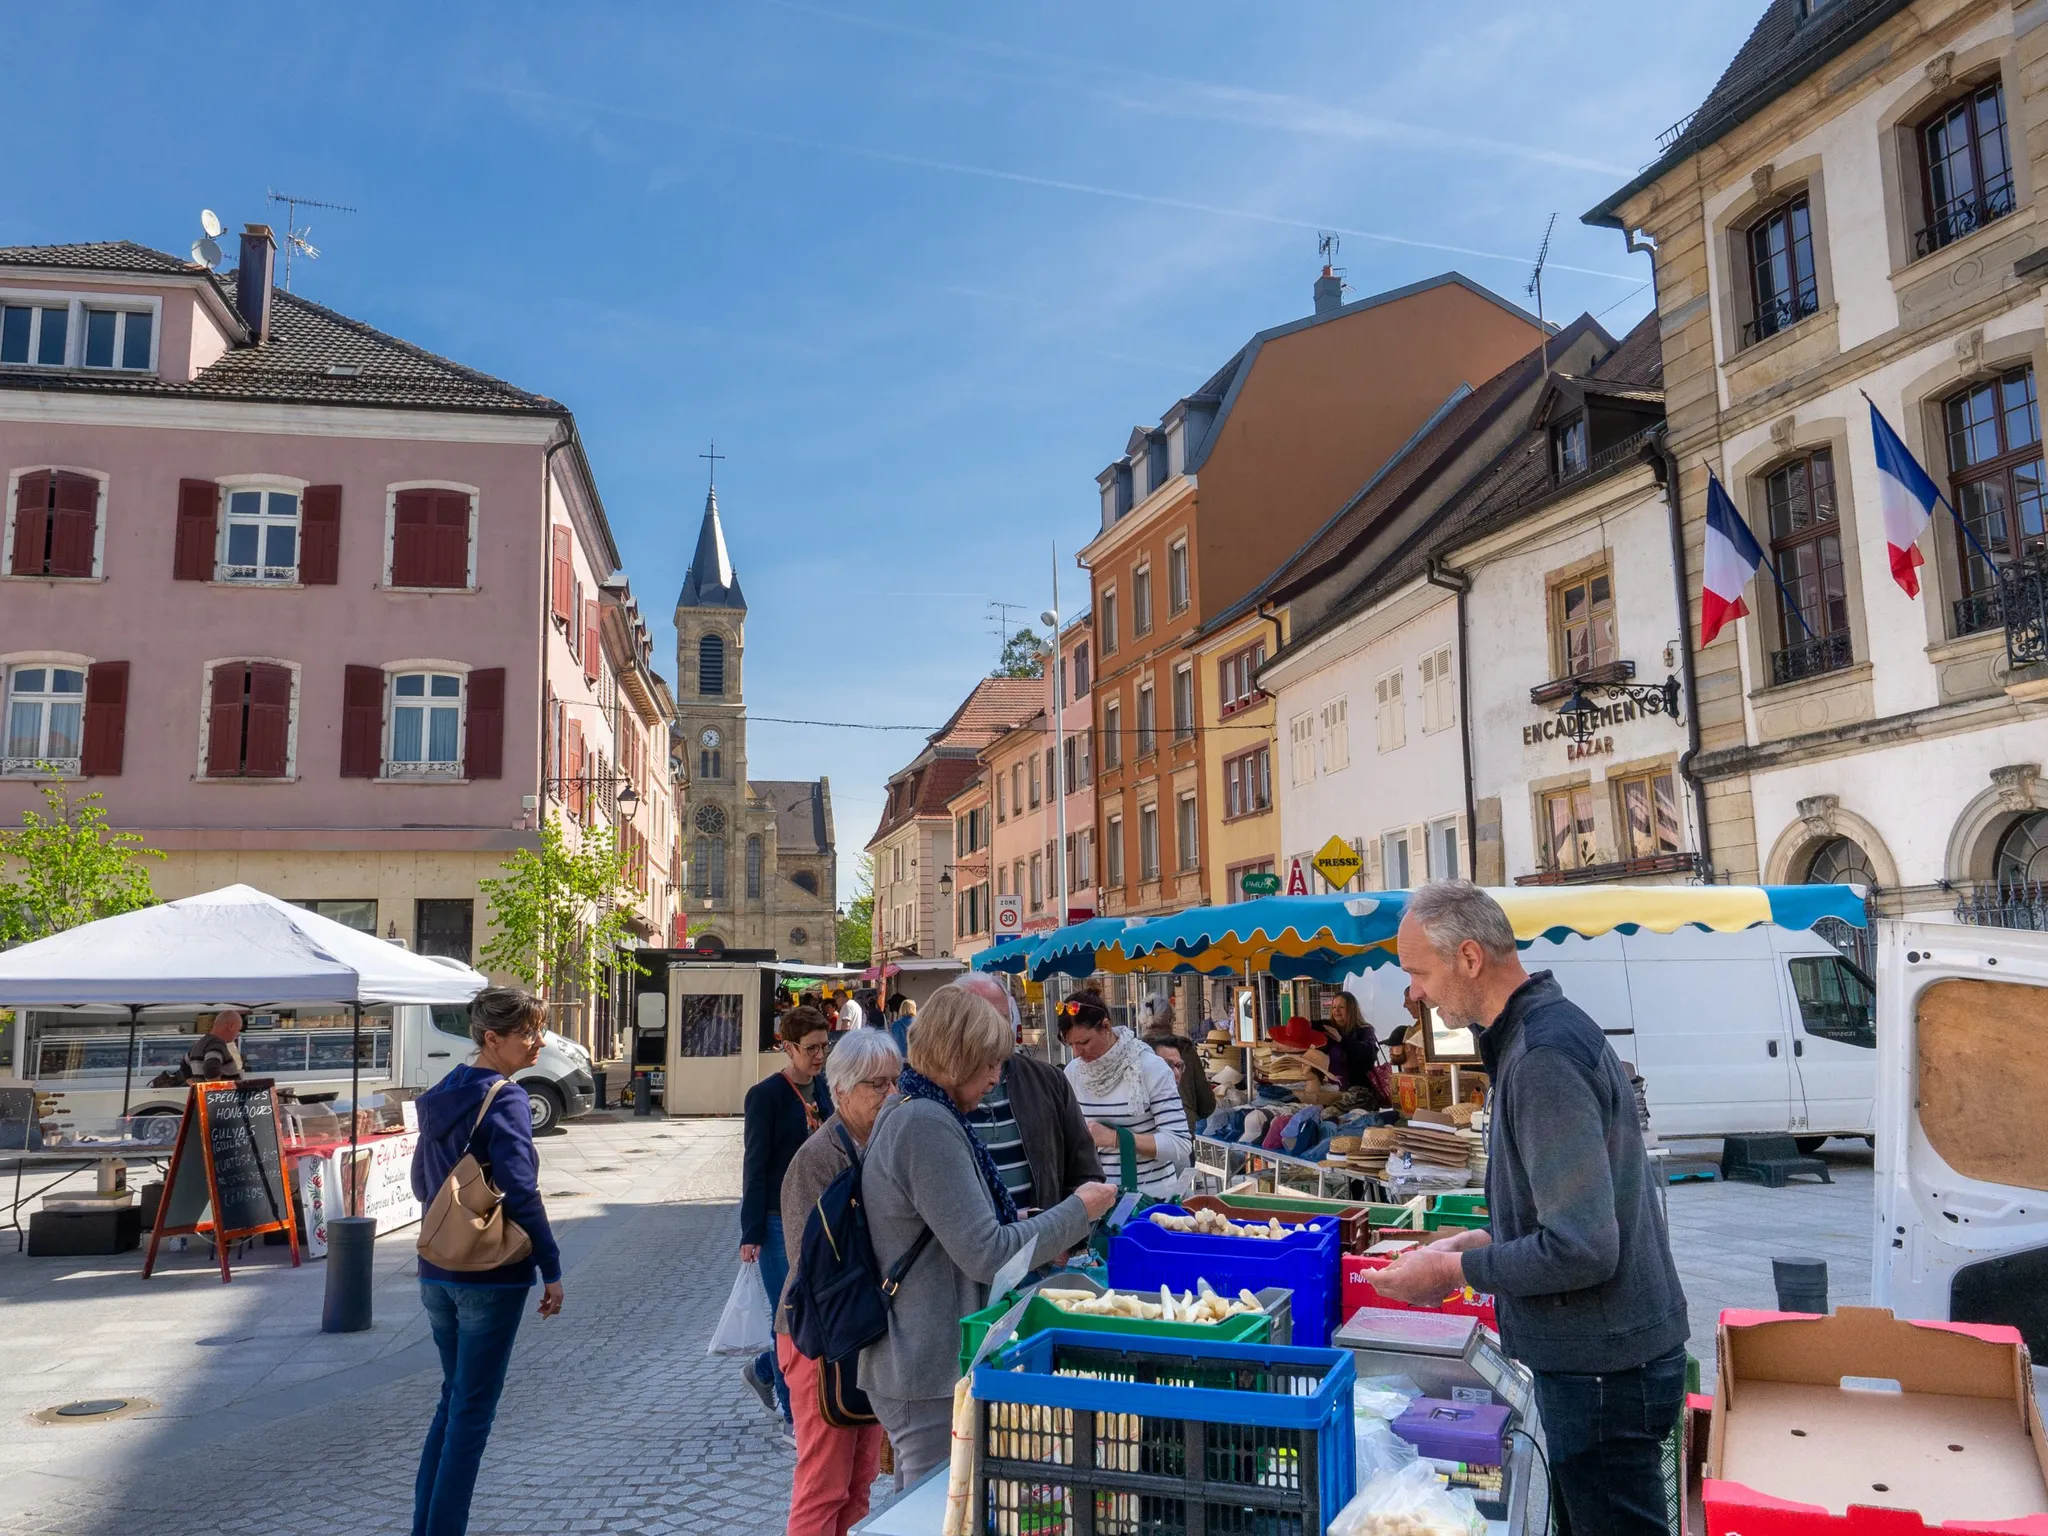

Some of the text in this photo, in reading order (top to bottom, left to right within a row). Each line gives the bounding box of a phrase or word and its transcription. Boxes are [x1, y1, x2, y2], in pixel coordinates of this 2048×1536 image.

[1567, 736, 1614, 760] BAZAR
[1319, 858, 1359, 867] PRESSE
[1245, 880, 1265, 889] PMU
[1003, 914, 1014, 922] 30
